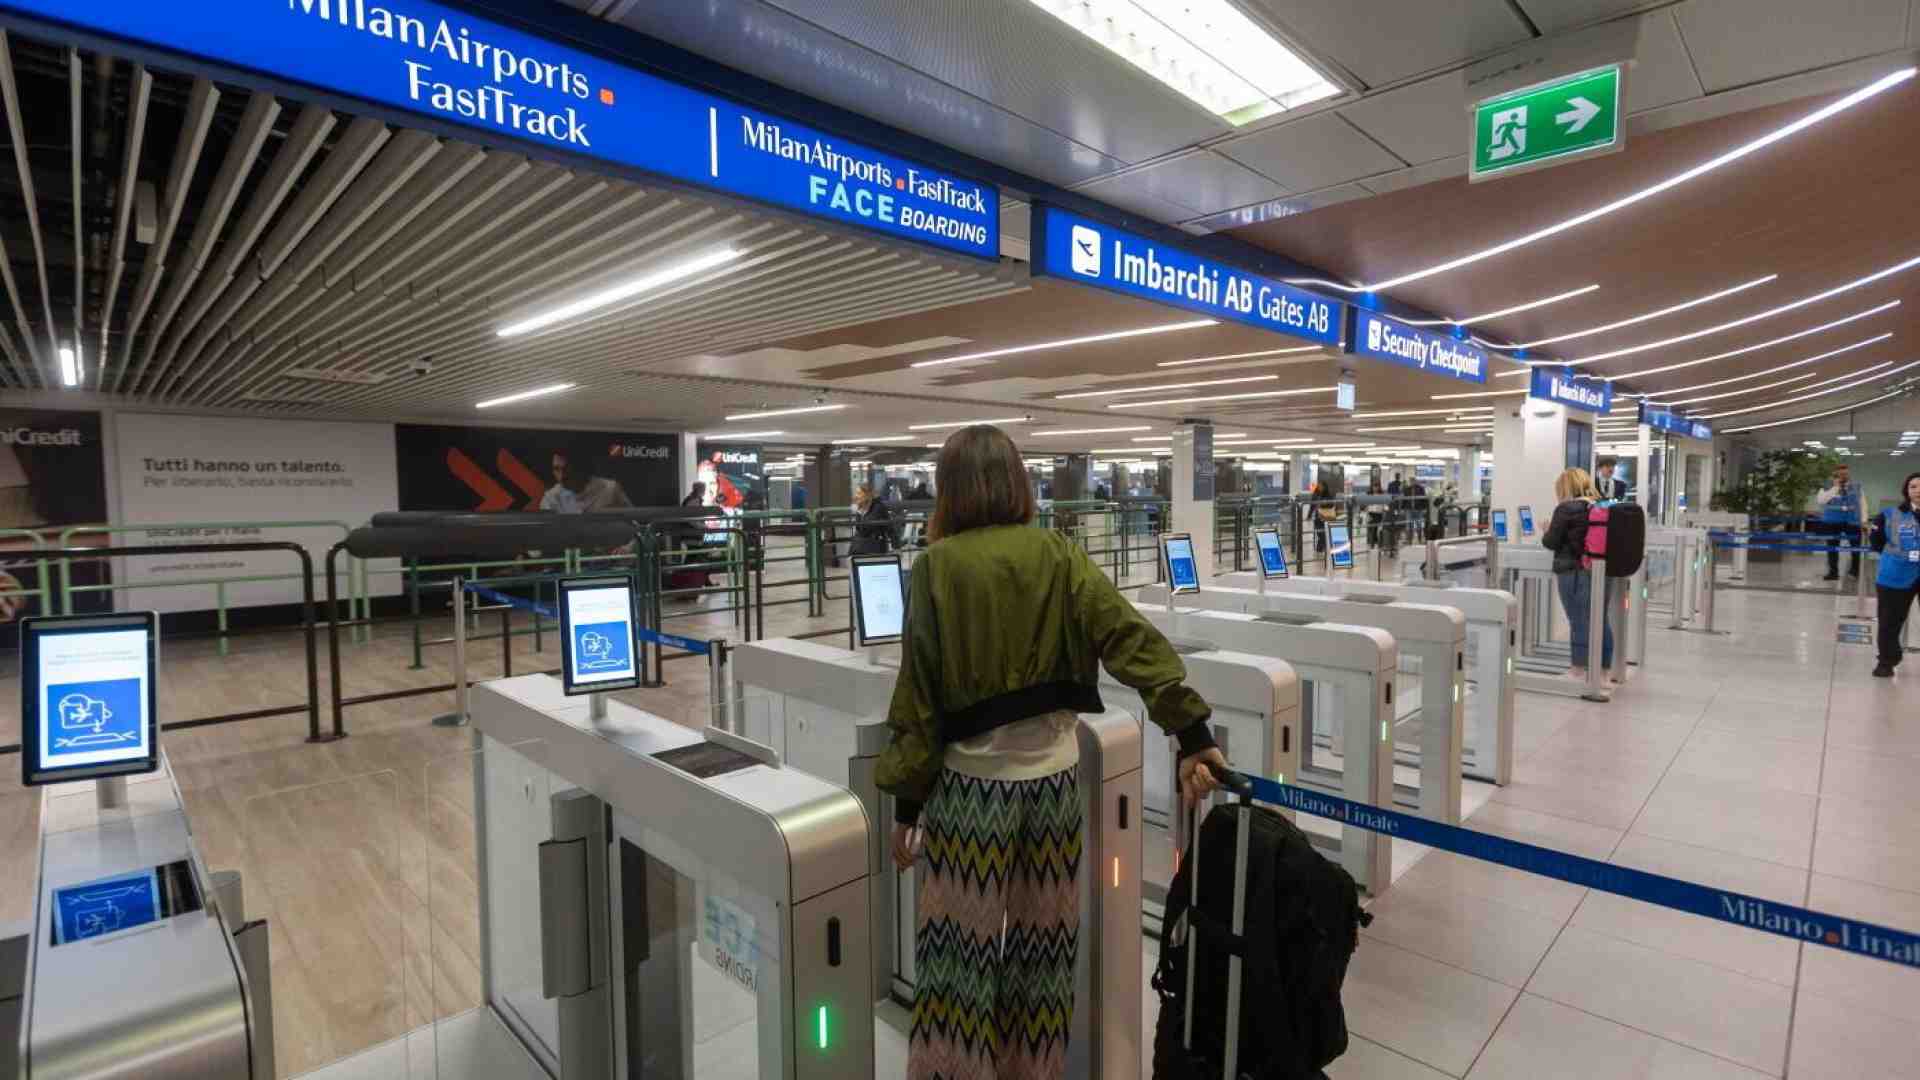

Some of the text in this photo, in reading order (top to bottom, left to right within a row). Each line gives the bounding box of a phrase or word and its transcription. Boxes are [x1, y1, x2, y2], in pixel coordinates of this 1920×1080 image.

[404, 60, 592, 147] FastTrack
[741, 115, 987, 215] MilanAirports FastTrack
[809, 174, 987, 246] FACE BOARDING
[1114, 240, 1329, 334] Imbarchi AB Gates AB
[1382, 325, 1481, 378] Security Checkpoint
[144, 457, 345, 473] Tutti hanno un talento.
[623, 445, 669, 458] UniCredit
[722, 451, 758, 464] UniCredit
[1279, 785, 1399, 833] Milano Linate
[1720, 894, 1823, 941] Milano
